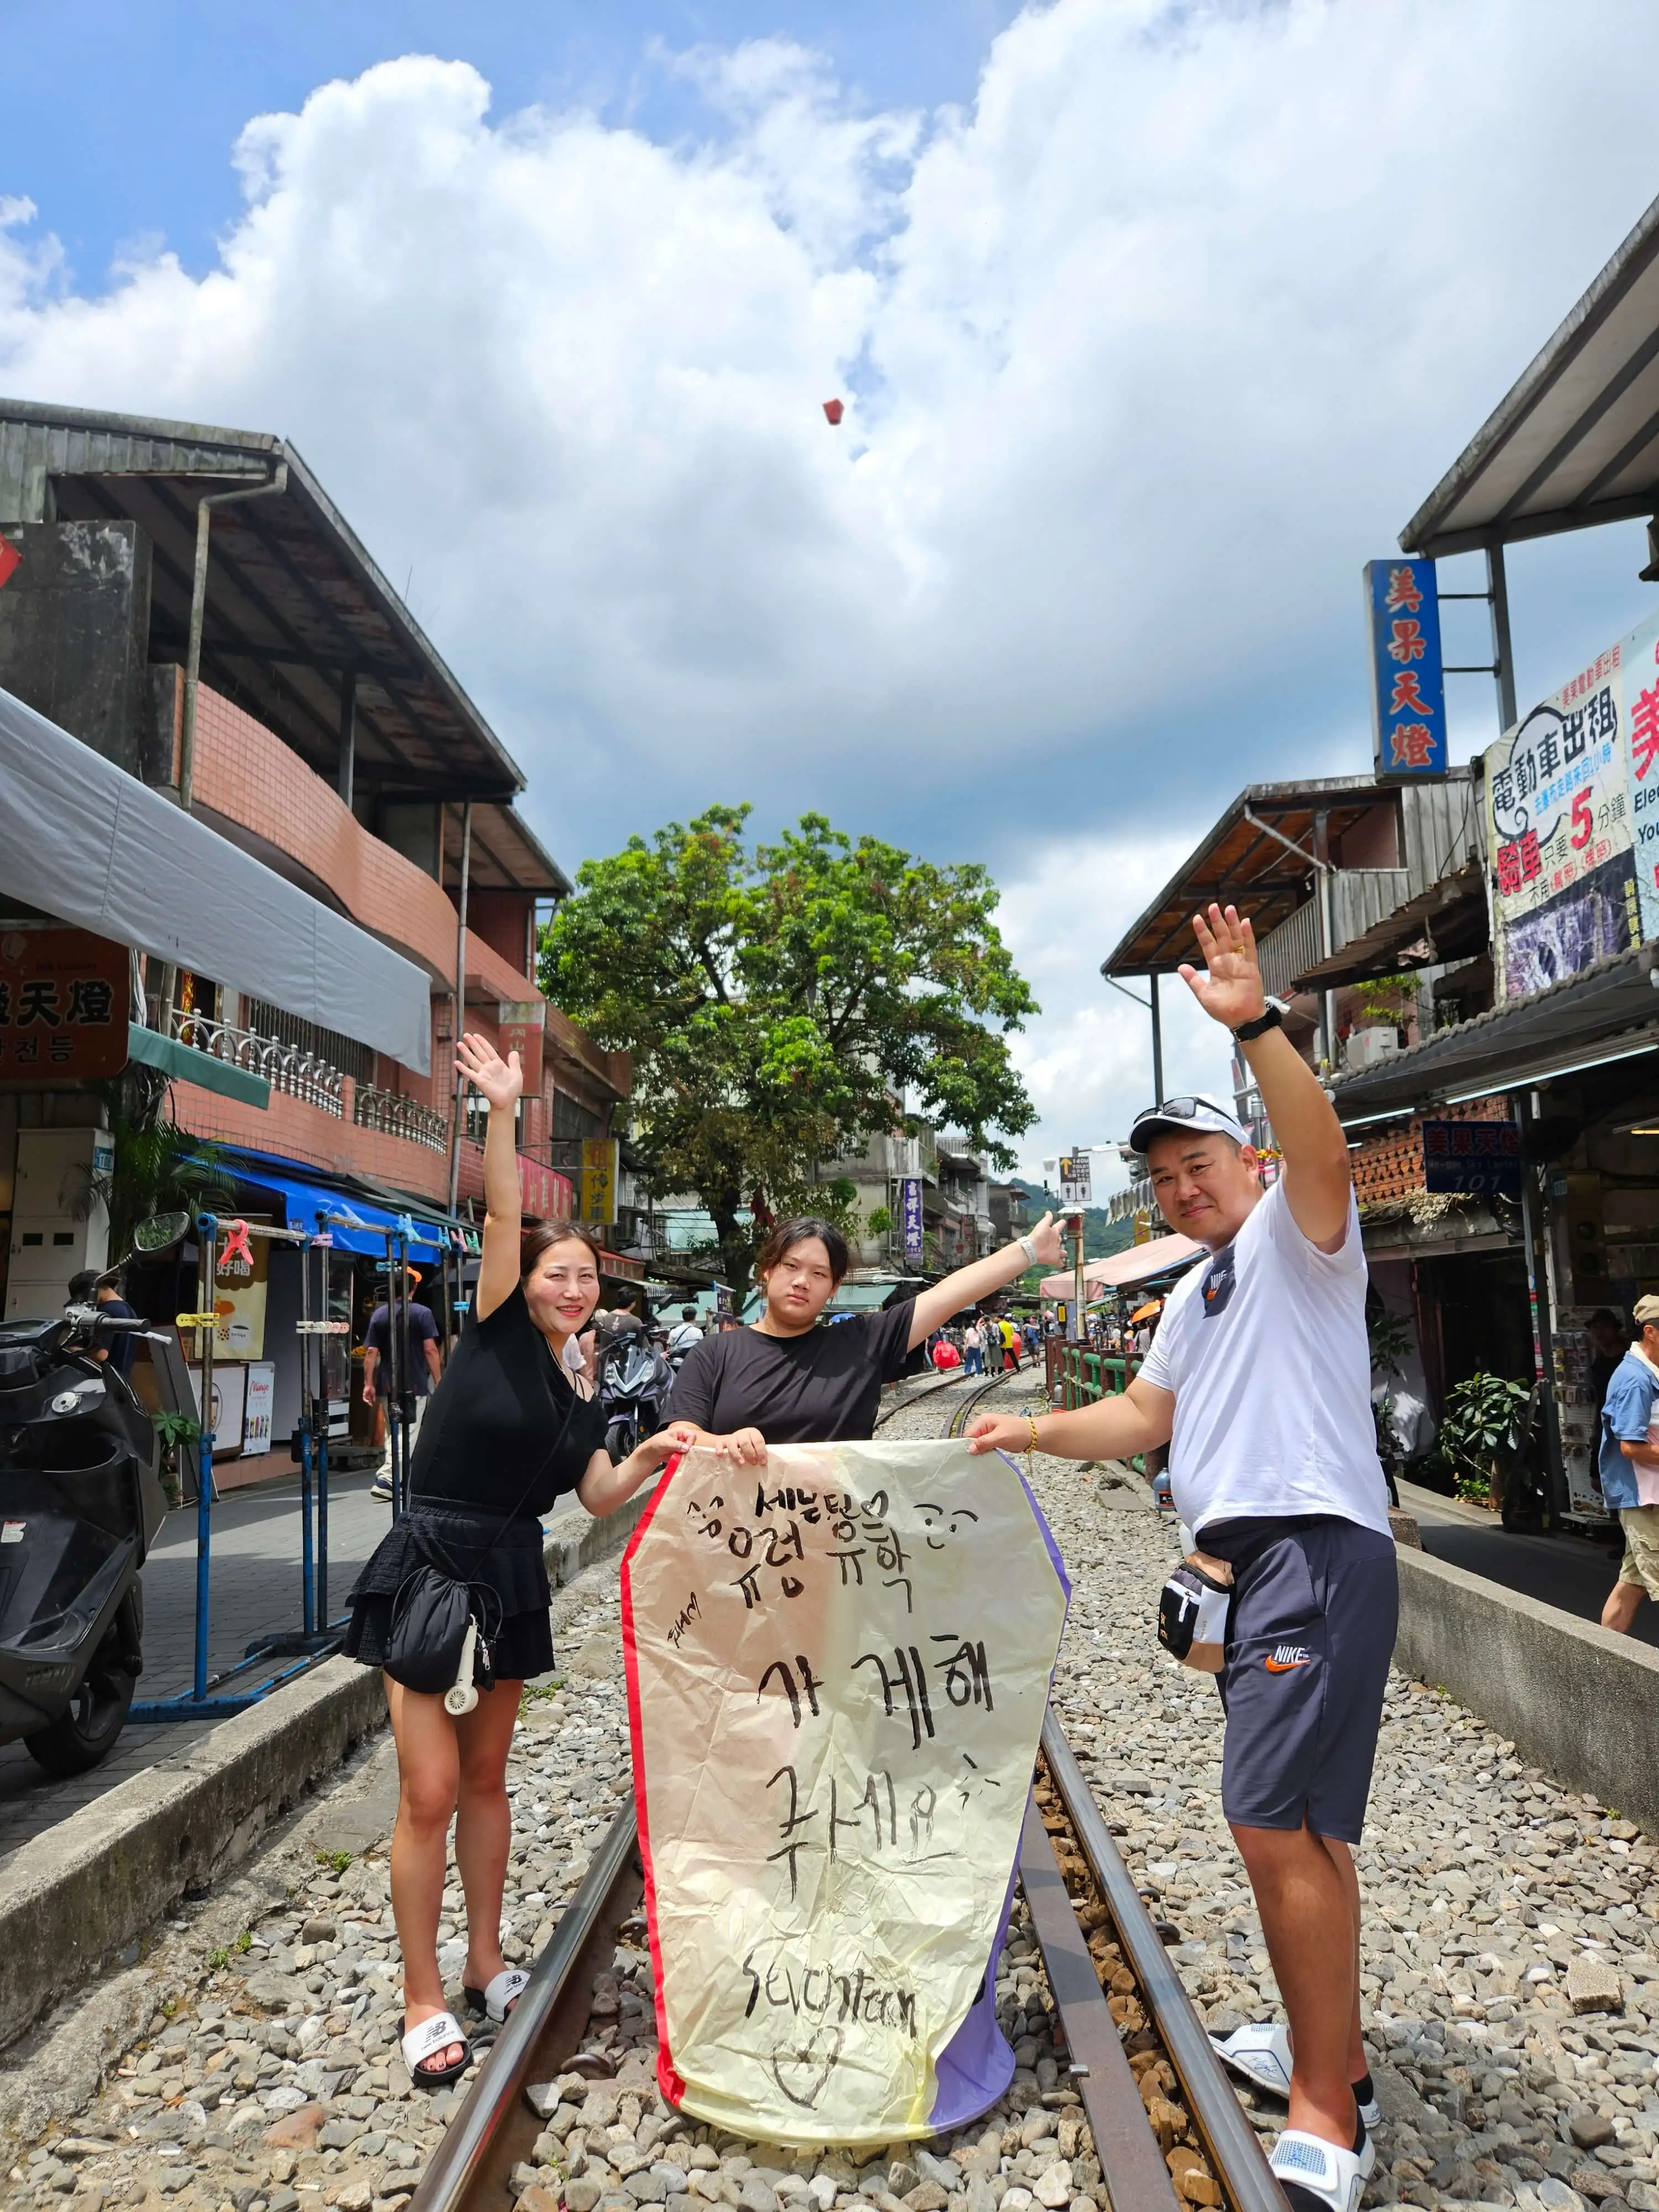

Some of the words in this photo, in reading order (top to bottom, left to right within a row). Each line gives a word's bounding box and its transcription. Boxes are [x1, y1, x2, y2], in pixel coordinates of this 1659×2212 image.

[1385, 566, 1437, 767] 美果天燈
[1492, 685, 1615, 812] 電動車出租
[1426, 1126, 1520, 1157] 美果天燈
[1453, 1175, 1502, 1191] 101
[1274, 1645, 1306, 1663] NIKE
[432, 2031, 455, 2043] balance
